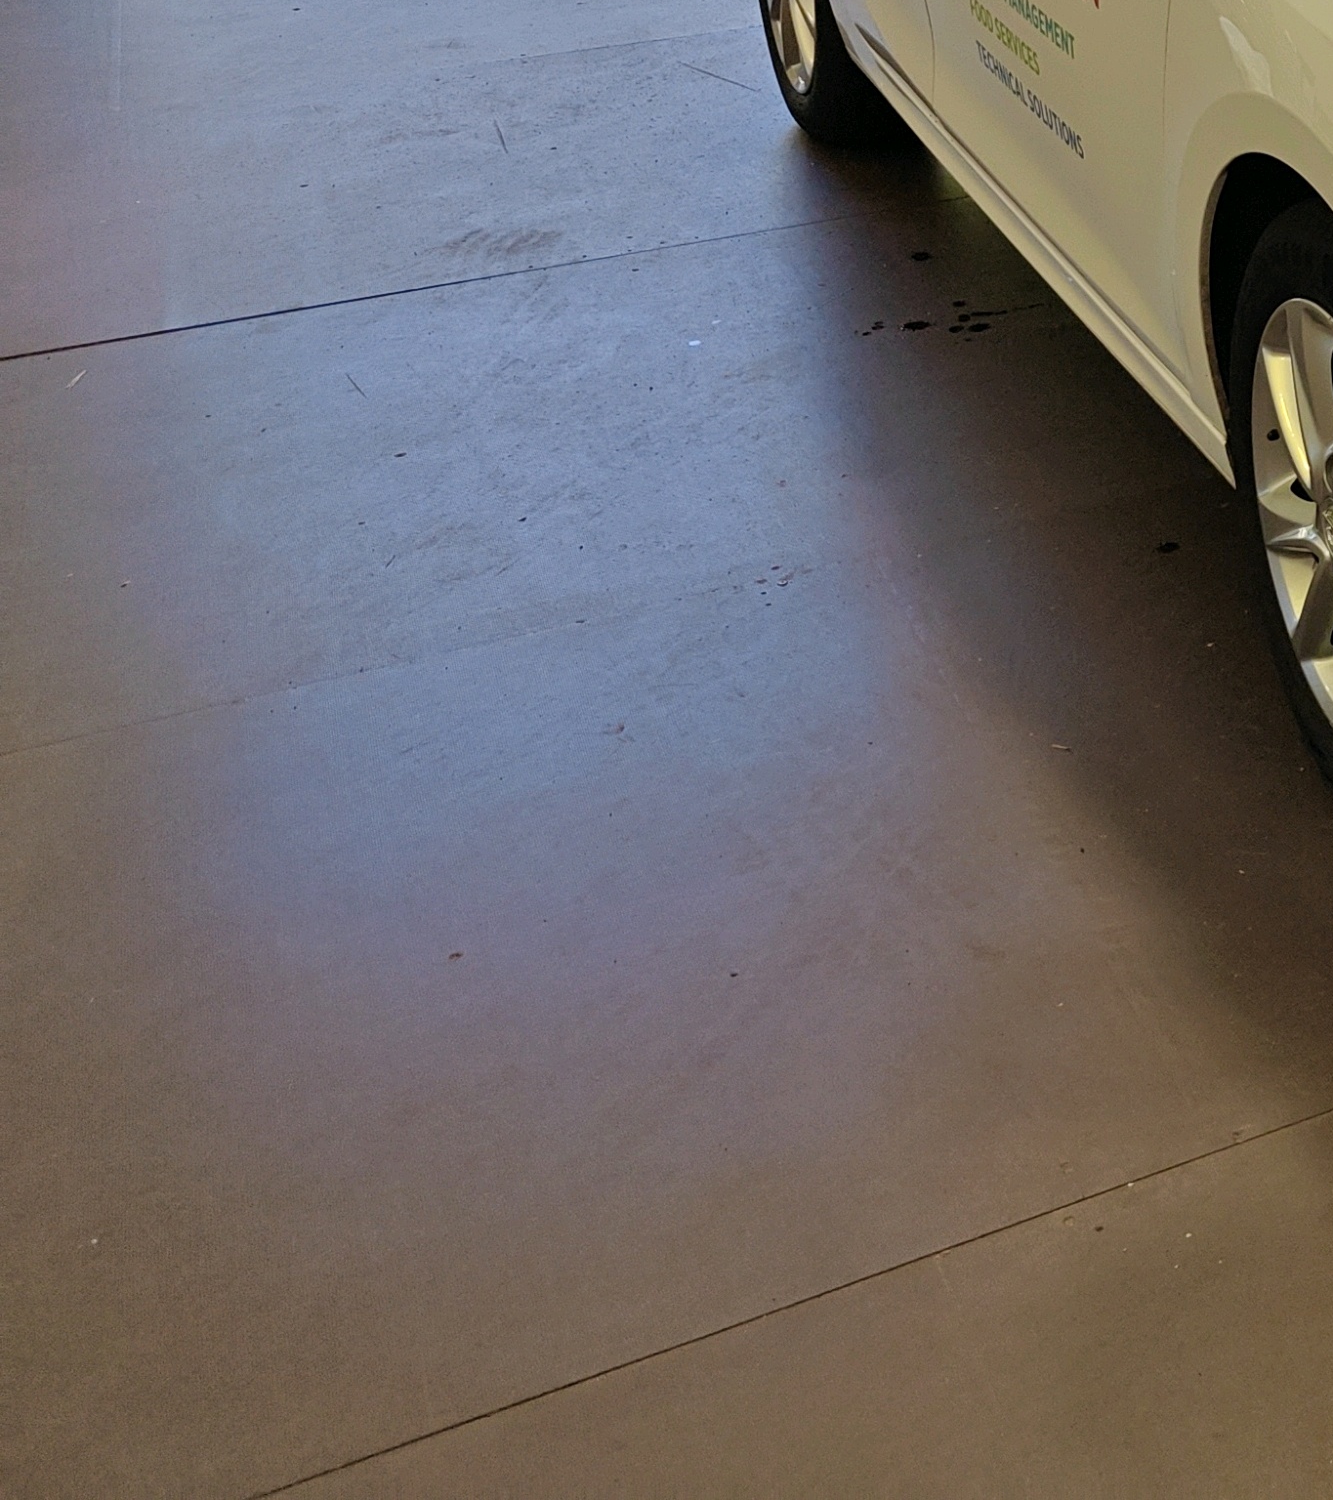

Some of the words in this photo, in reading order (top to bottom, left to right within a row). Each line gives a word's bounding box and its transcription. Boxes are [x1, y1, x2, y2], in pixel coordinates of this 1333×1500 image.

[995, 17, 1041, 76] SERVICES
[975, 40, 1028, 107] TECHNICAL
[1027, 89, 1085, 160] SOLUTIONS
